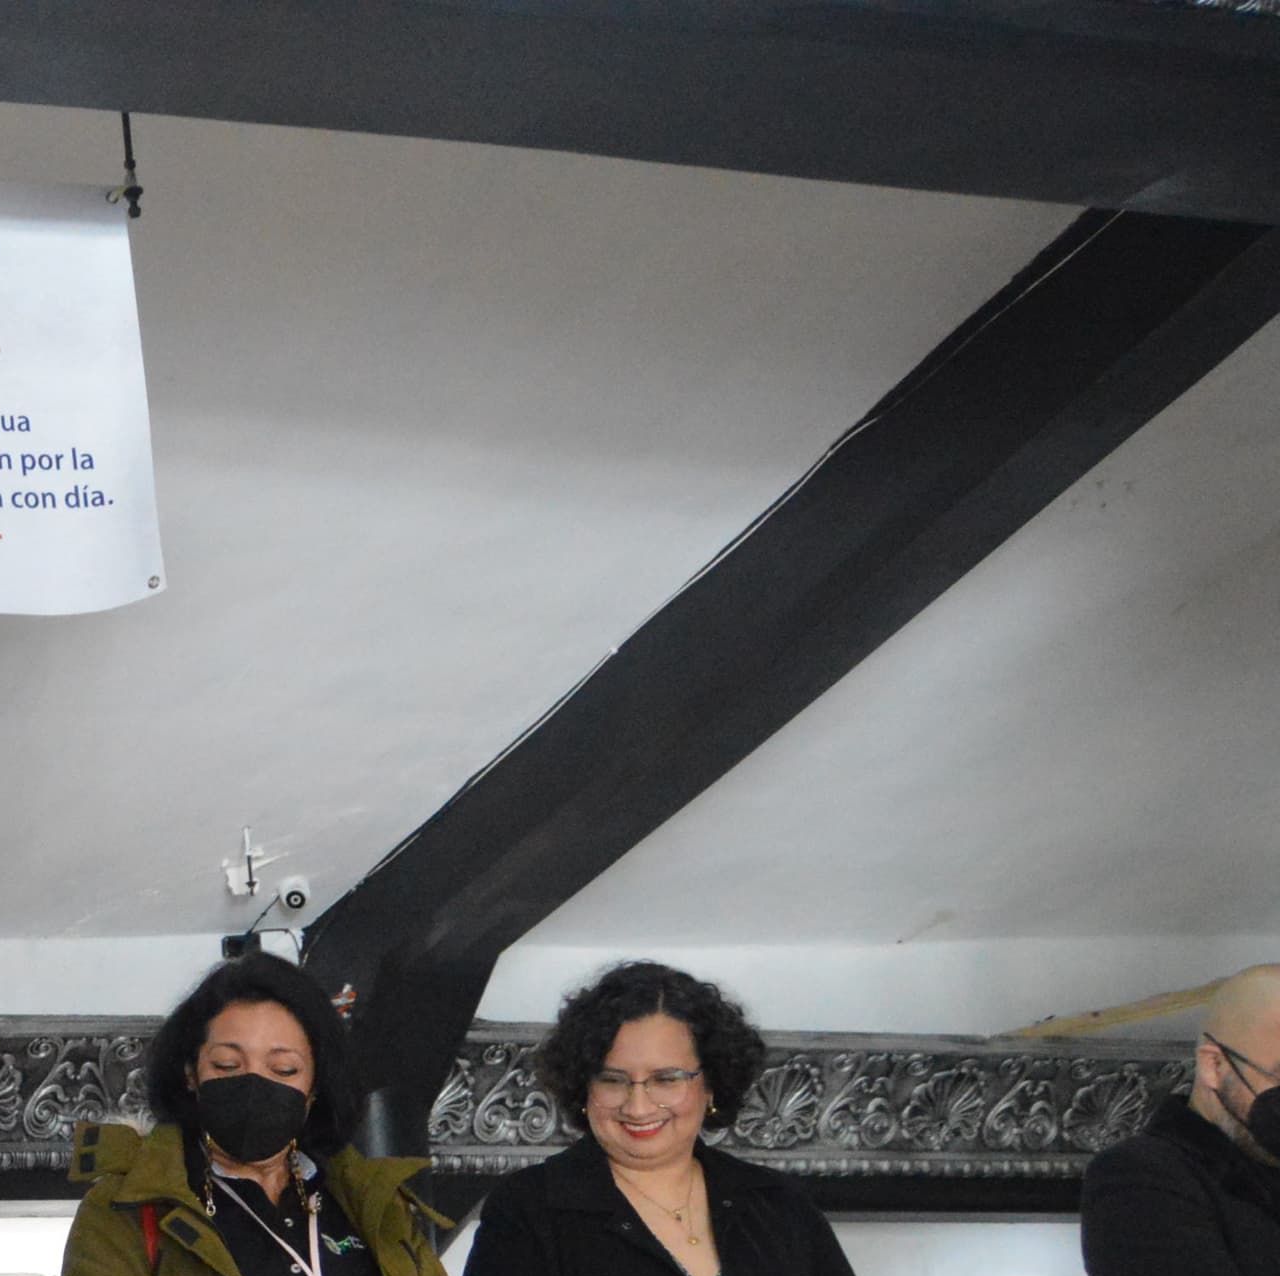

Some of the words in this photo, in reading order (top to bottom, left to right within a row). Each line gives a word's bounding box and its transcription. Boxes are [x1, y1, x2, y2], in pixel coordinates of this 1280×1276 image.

[21, 451, 64, 476] por
[71, 447, 94, 470] la
[11, 489, 57, 509] con
[65, 485, 114, 509] día.
